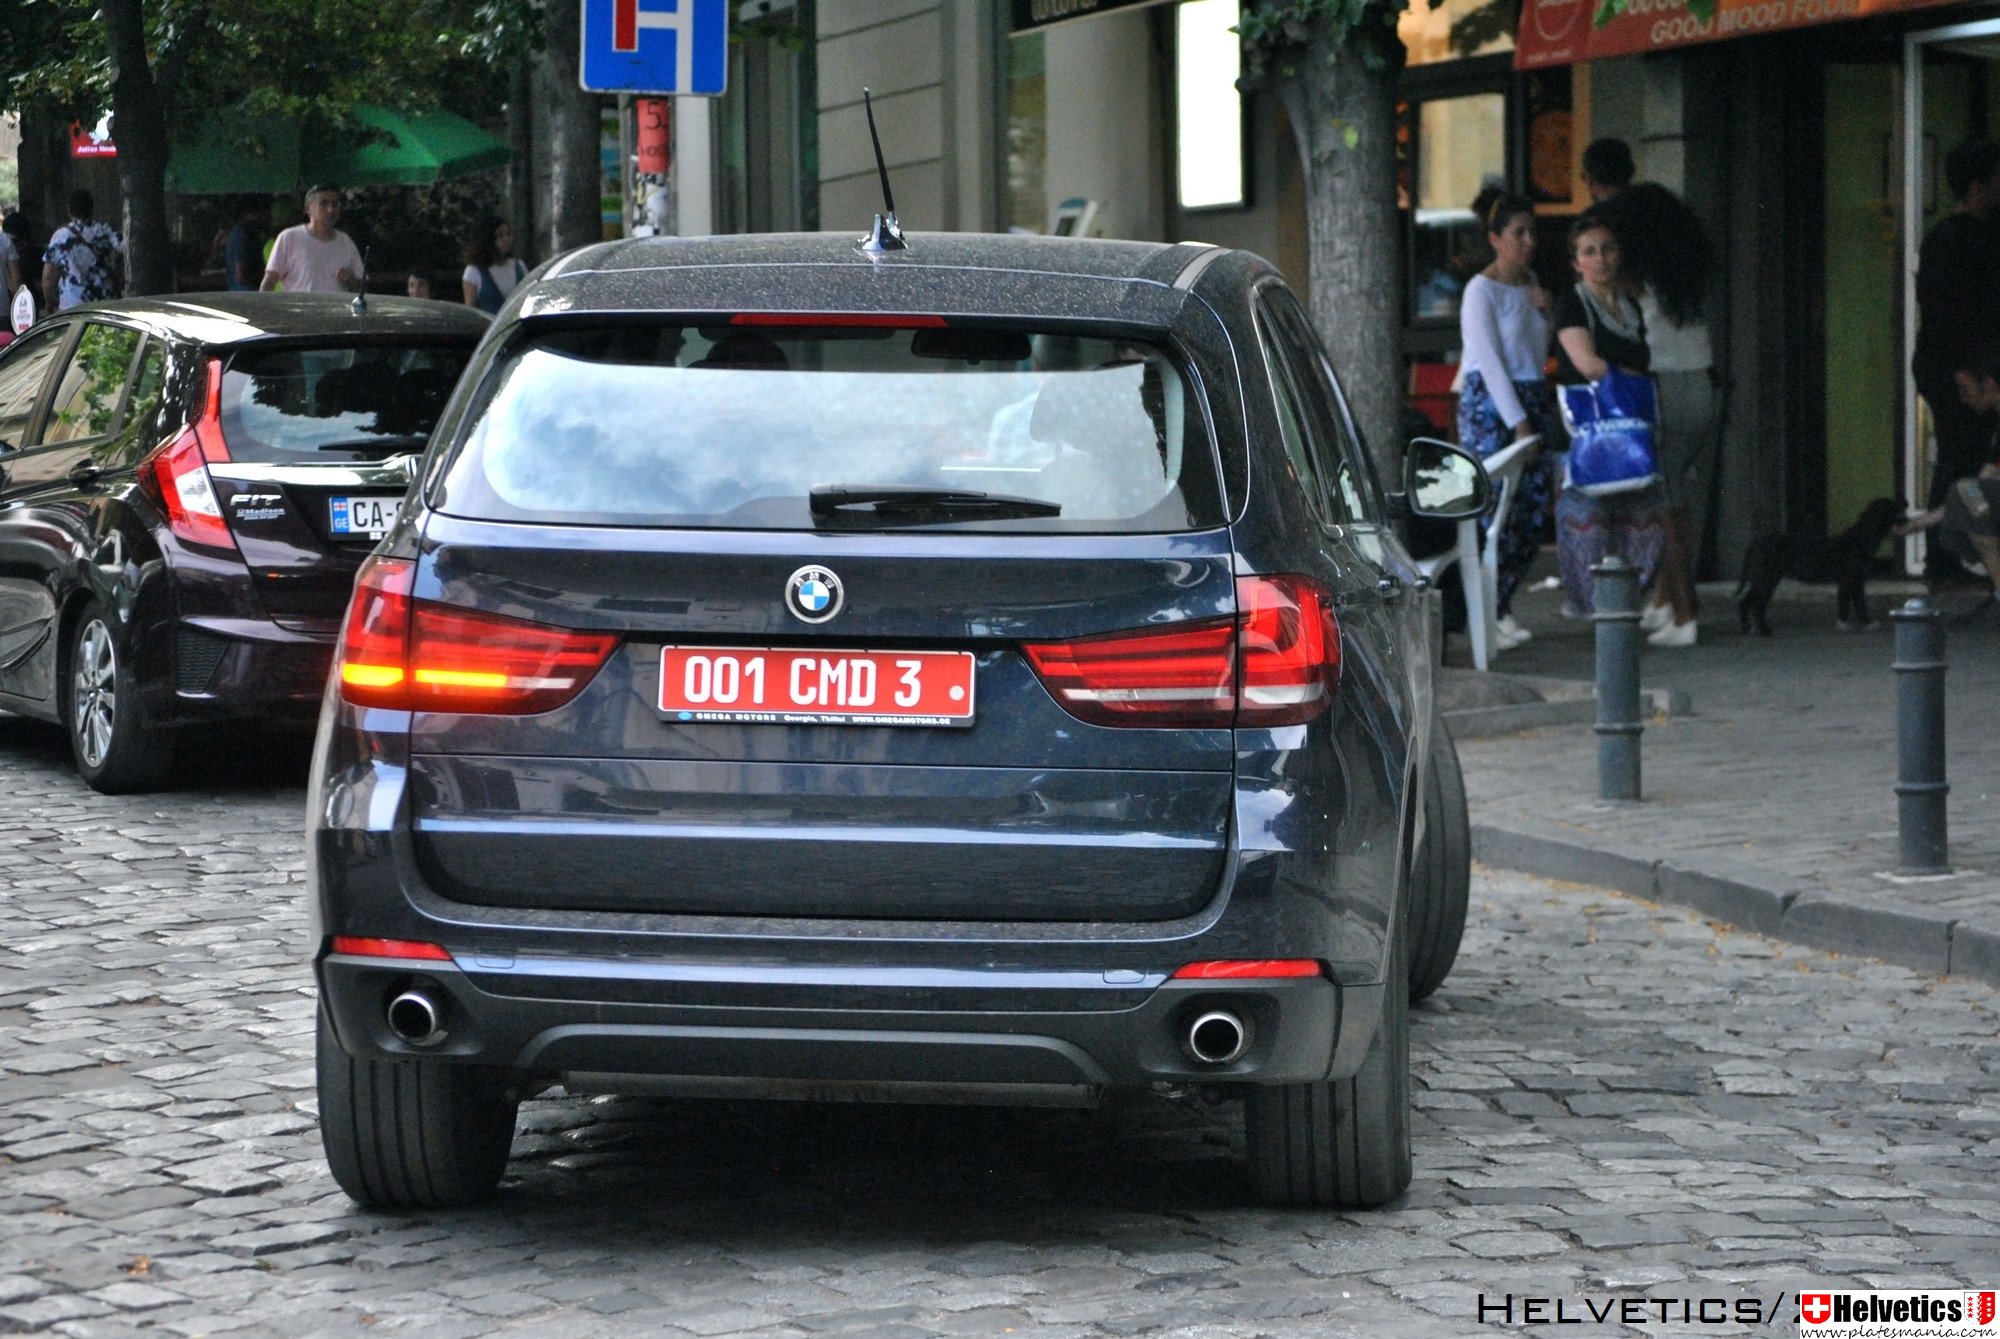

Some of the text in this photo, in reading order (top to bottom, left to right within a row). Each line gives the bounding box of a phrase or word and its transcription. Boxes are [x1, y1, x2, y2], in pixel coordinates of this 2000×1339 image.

[1718, 3, 1786, 33] MOOD
[230, 494, 282, 506] FIT
[334, 517, 349, 529] GE
[684, 655, 922, 708] 001 CMD 3
[696, 712, 731, 720] OMEGA
[735, 713, 777, 721] MOTORS
